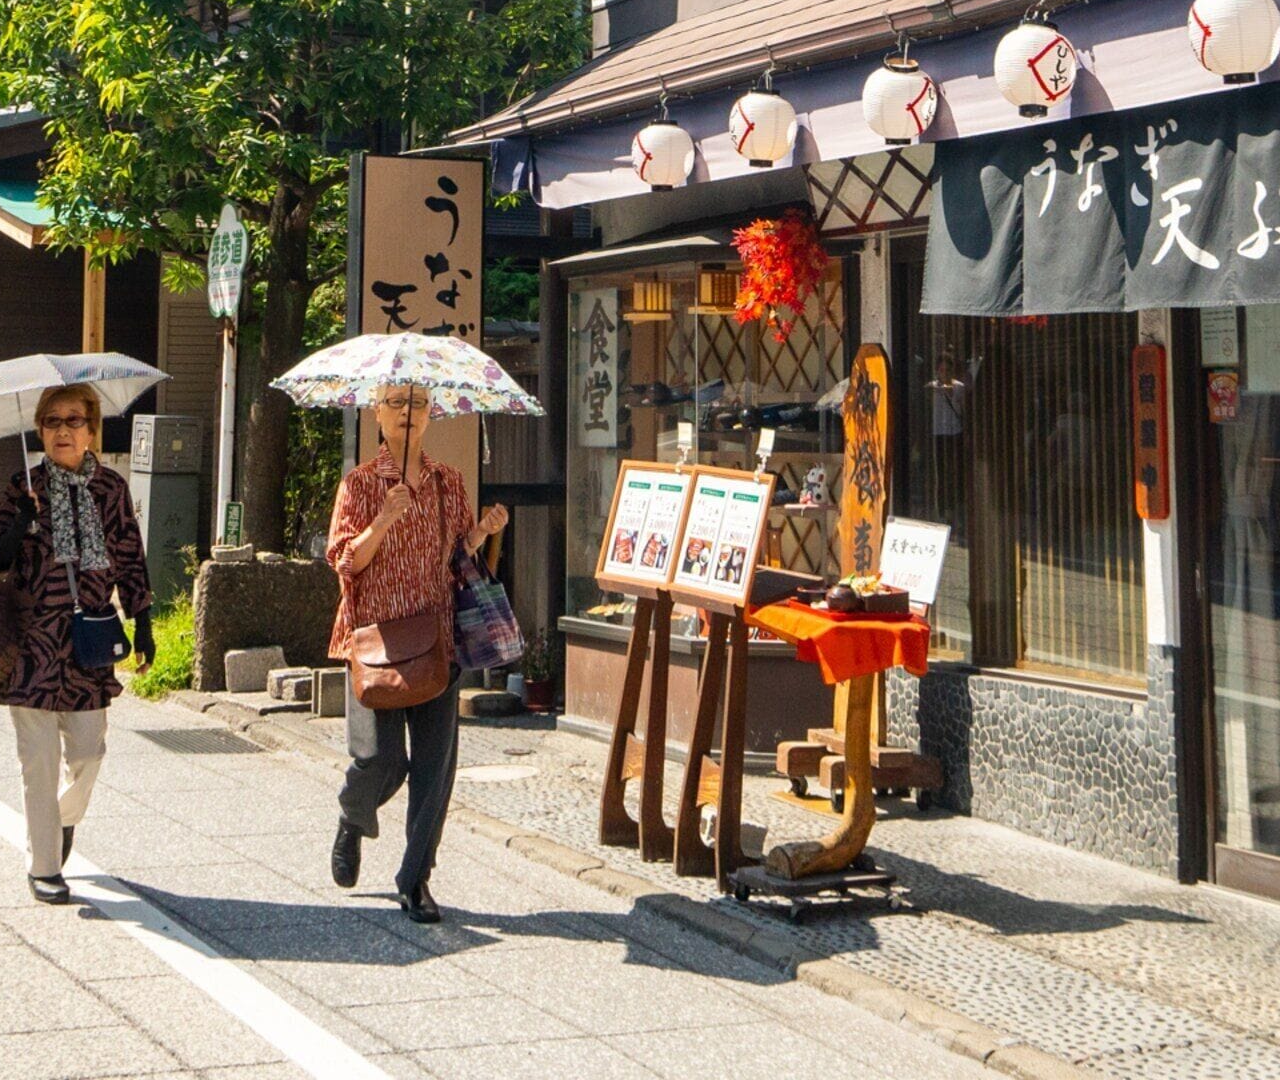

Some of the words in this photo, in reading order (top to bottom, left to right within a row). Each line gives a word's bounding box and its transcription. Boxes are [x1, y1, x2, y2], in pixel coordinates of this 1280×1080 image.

[1049, 44, 1069, 91] ひしや
[1031, 118, 1178, 218] うなぎ
[211, 229, 244, 268] 表参道
[582, 298, 616, 431] 食堂
